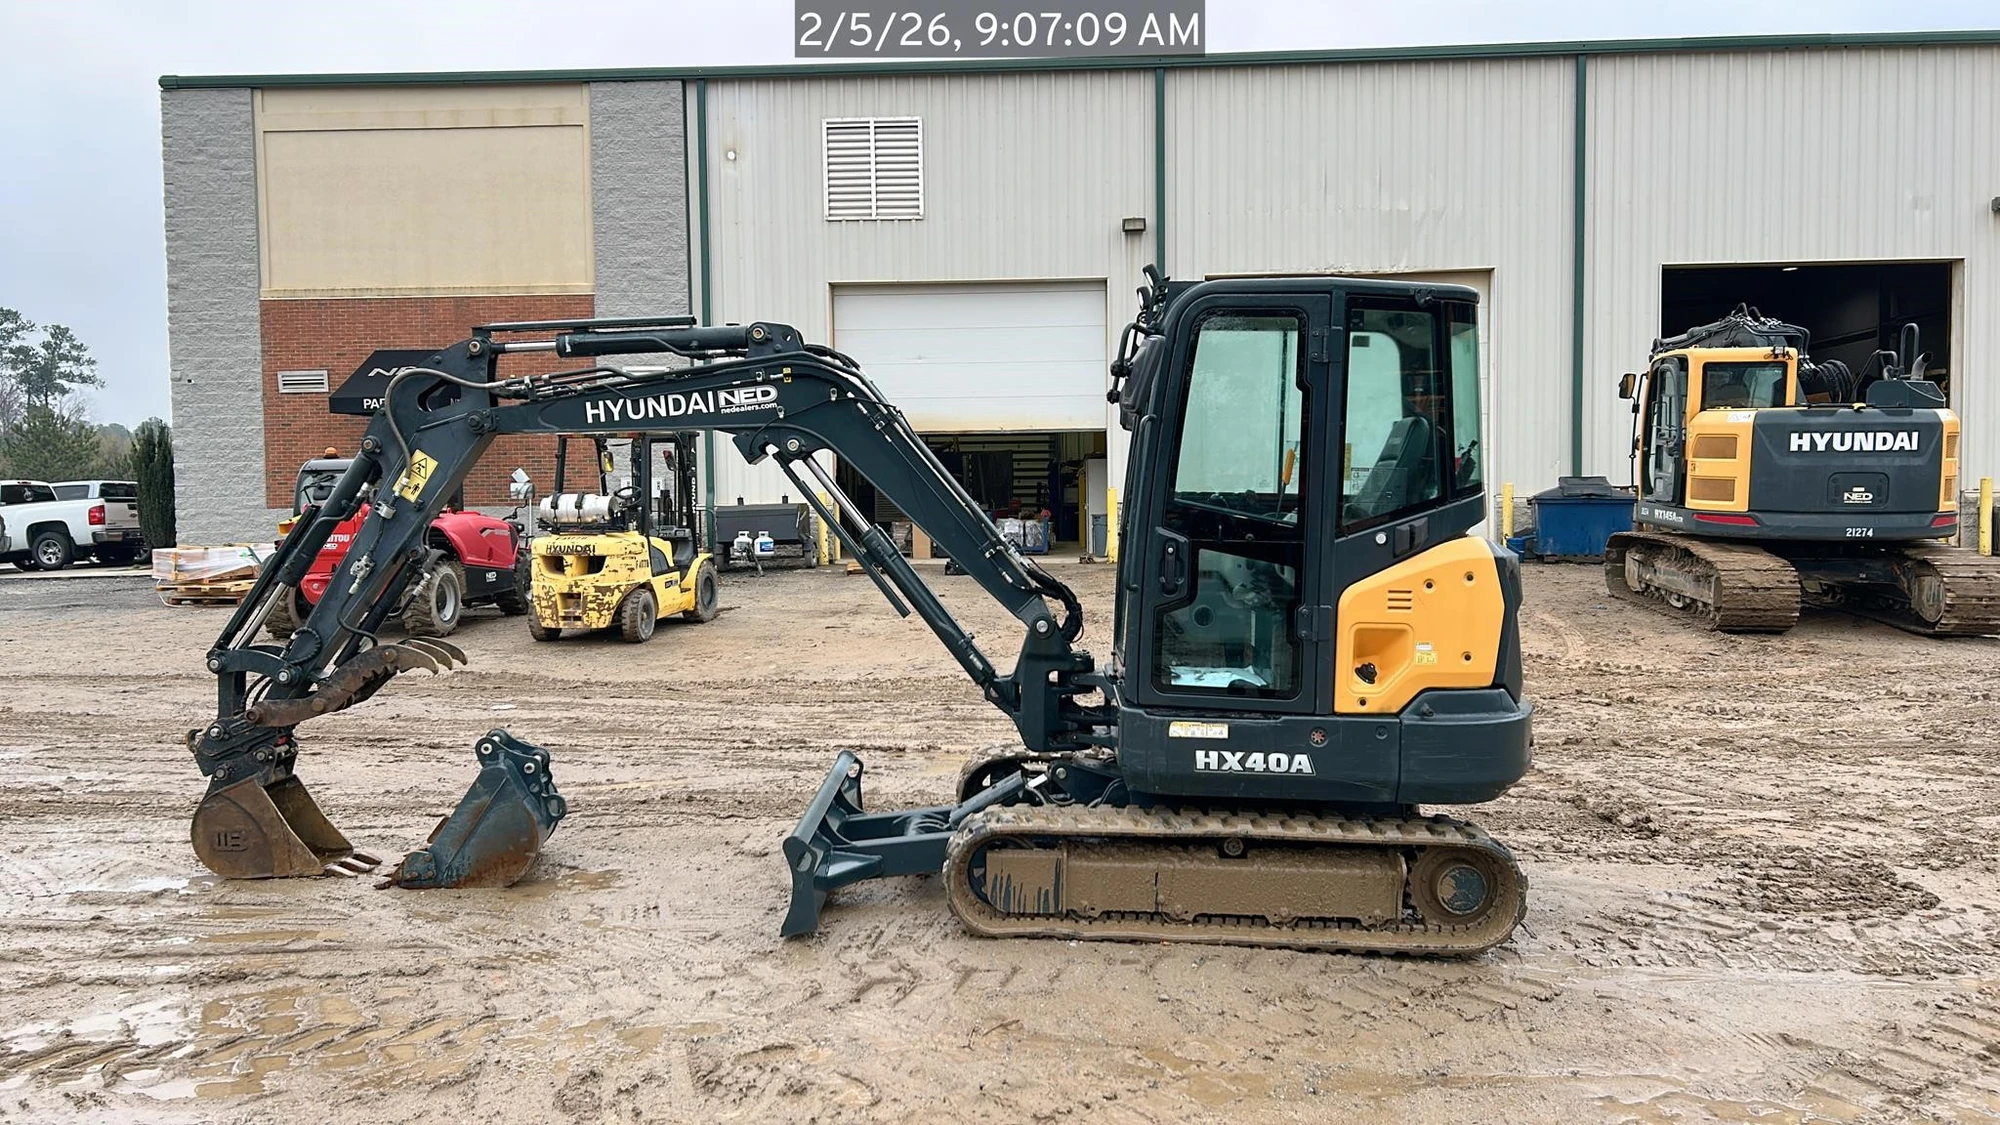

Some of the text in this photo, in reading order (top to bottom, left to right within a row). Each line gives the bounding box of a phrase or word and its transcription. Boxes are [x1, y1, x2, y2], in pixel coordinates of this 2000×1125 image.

[719, 385, 778, 408] NED
[585, 390, 715, 424] HYUNDAI
[720, 401, 778, 415] nedealers.com
[1789, 431, 1919, 452] HYUNDAI
[1843, 491, 1874, 501] NED
[1845, 527, 1874, 538] 21274
[545, 543, 596, 556] HYUNDAI
[1194, 749, 1315, 775] HX40A
